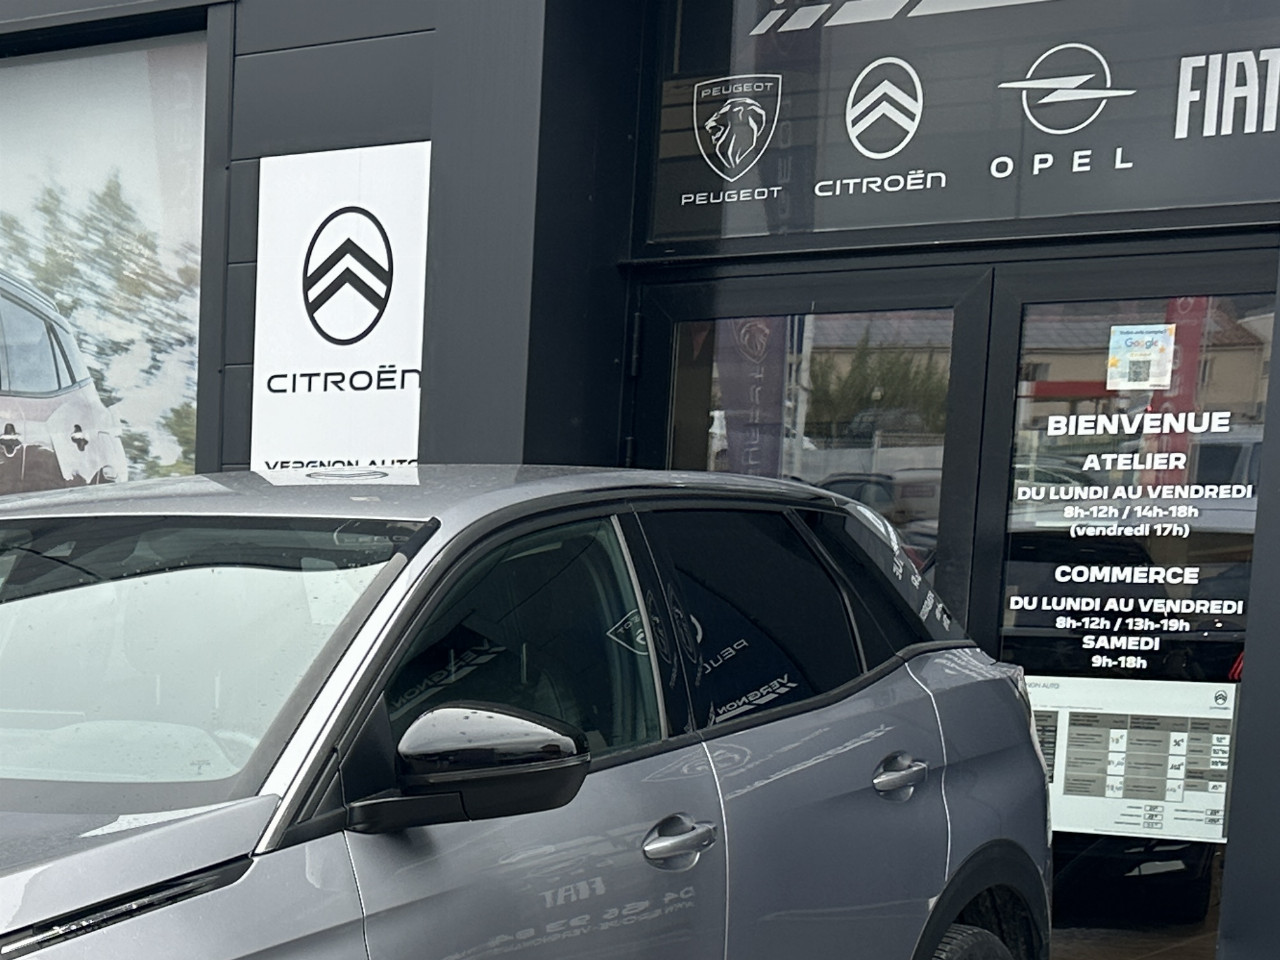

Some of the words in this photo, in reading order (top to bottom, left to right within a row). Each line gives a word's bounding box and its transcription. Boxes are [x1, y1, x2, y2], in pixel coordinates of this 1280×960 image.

[701, 82, 774, 99] PEUGEOT
[1174, 47, 1280, 140] FIAT
[989, 147, 1133, 179] OPEL
[681, 186, 782, 206] PEUGEOT
[1047, 411, 1231, 436] BIENVENUE
[1081, 452, 1187, 471] ATELIER
[1017, 486, 1046, 500] DU
[1049, 486, 1109, 500] LUNDI
[1112, 485, 1142, 499] AU
[1147, 484, 1253, 499] VENDREDI
[1063, 505, 1119, 519] 8h-12h
[1133, 505, 1199, 519] 14h-18h
[1070, 523, 1150, 538] (vendredi
[1153, 523, 1190, 538] 17h)
[1054, 565, 1200, 585] COMMERCE
[1009, 596, 1038, 610] DU
[1041, 596, 1100, 612] LUNDI
[1103, 598, 1134, 612] AU
[1138, 599, 1244, 615] VENDREDI
[1055, 616, 1111, 630] 8h-12h
[1124, 617, 1191, 632] 13h-19h
[1082, 635, 1160, 651] SAMEDI
[1091, 655, 1148, 669] 9h-18h
